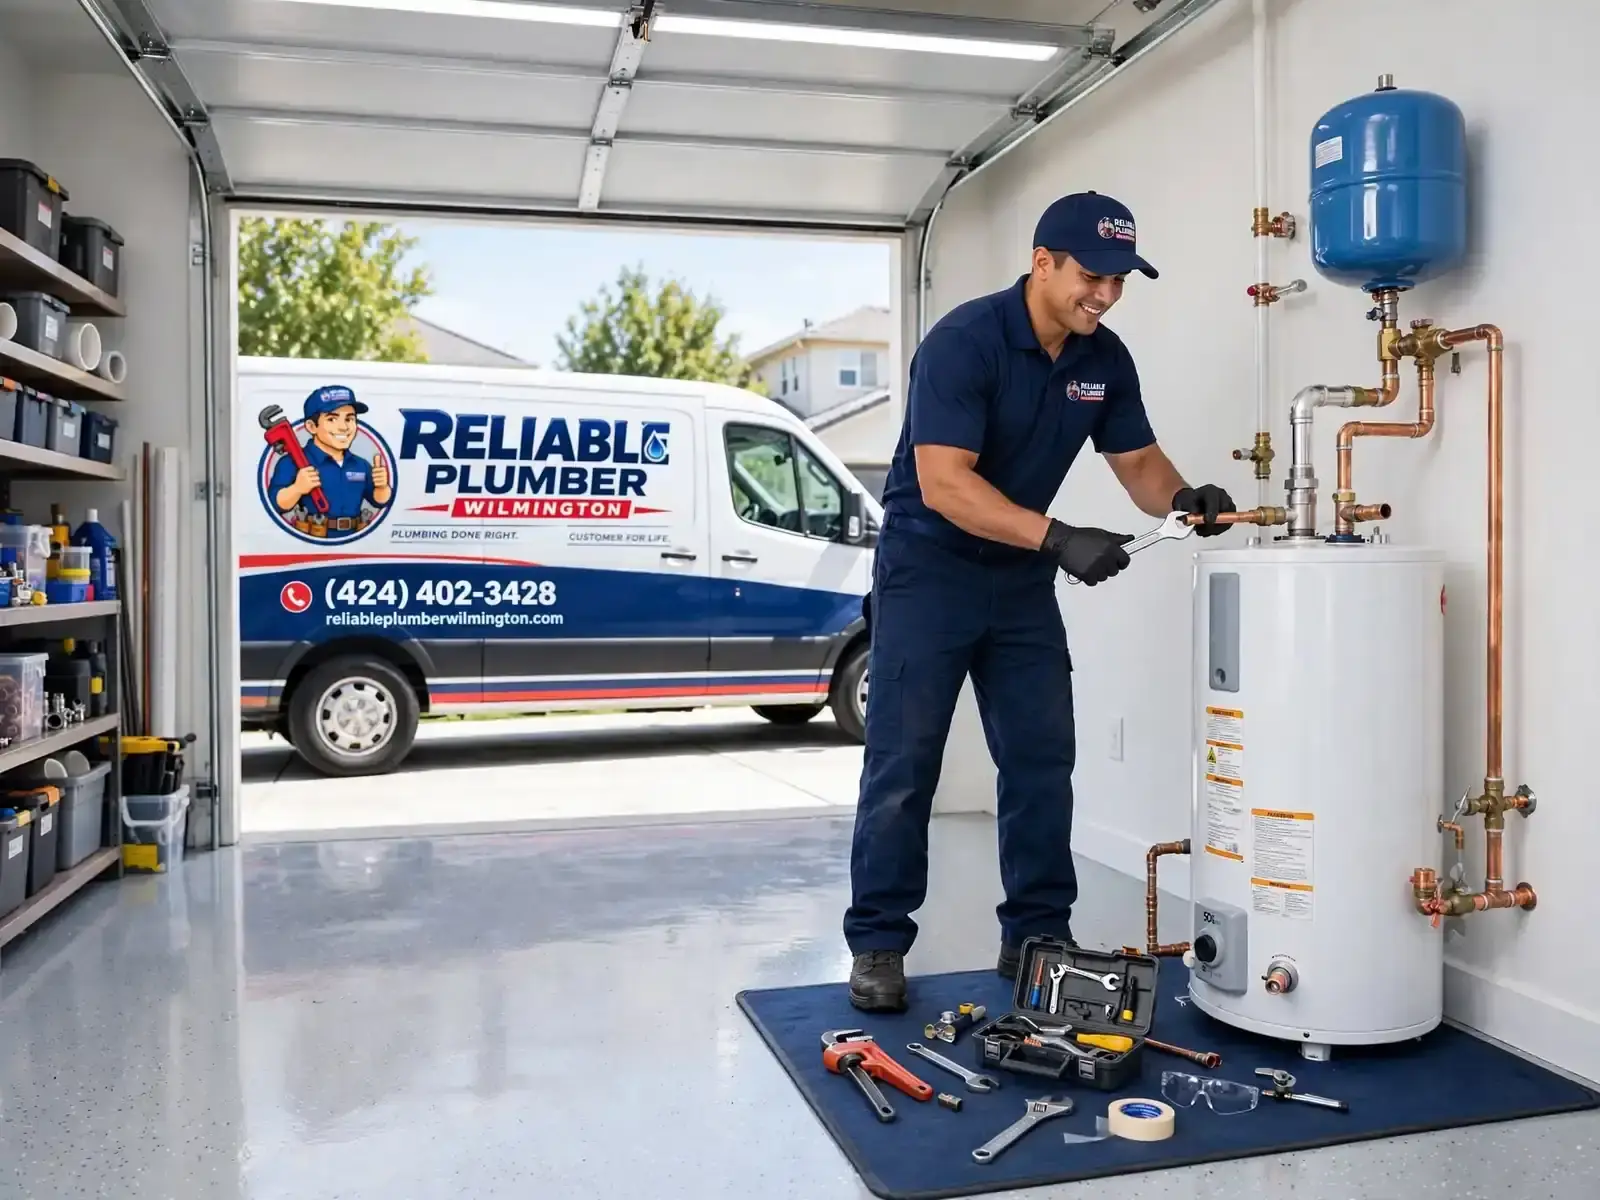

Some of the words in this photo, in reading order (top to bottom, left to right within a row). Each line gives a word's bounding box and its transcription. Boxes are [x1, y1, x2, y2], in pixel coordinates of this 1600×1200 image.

[399, 408, 670, 464] RELIABLE
[425, 465, 647, 496] PLUMBER
[464, 500, 621, 517] WILMINGTON
[391, 530, 447, 539] PLUMBING
[451, 530, 481, 539] DONE
[484, 531, 519, 540] RIGHT.
[569, 532, 624, 541] CUSTOMER
[626, 533, 646, 542] FOR
[648, 534, 671, 543] LIFE.
[325, 578, 409, 609] (424)
[416, 580, 557, 606] 402-3428
[326, 611, 563, 628] reliableplumberwilmington.com
